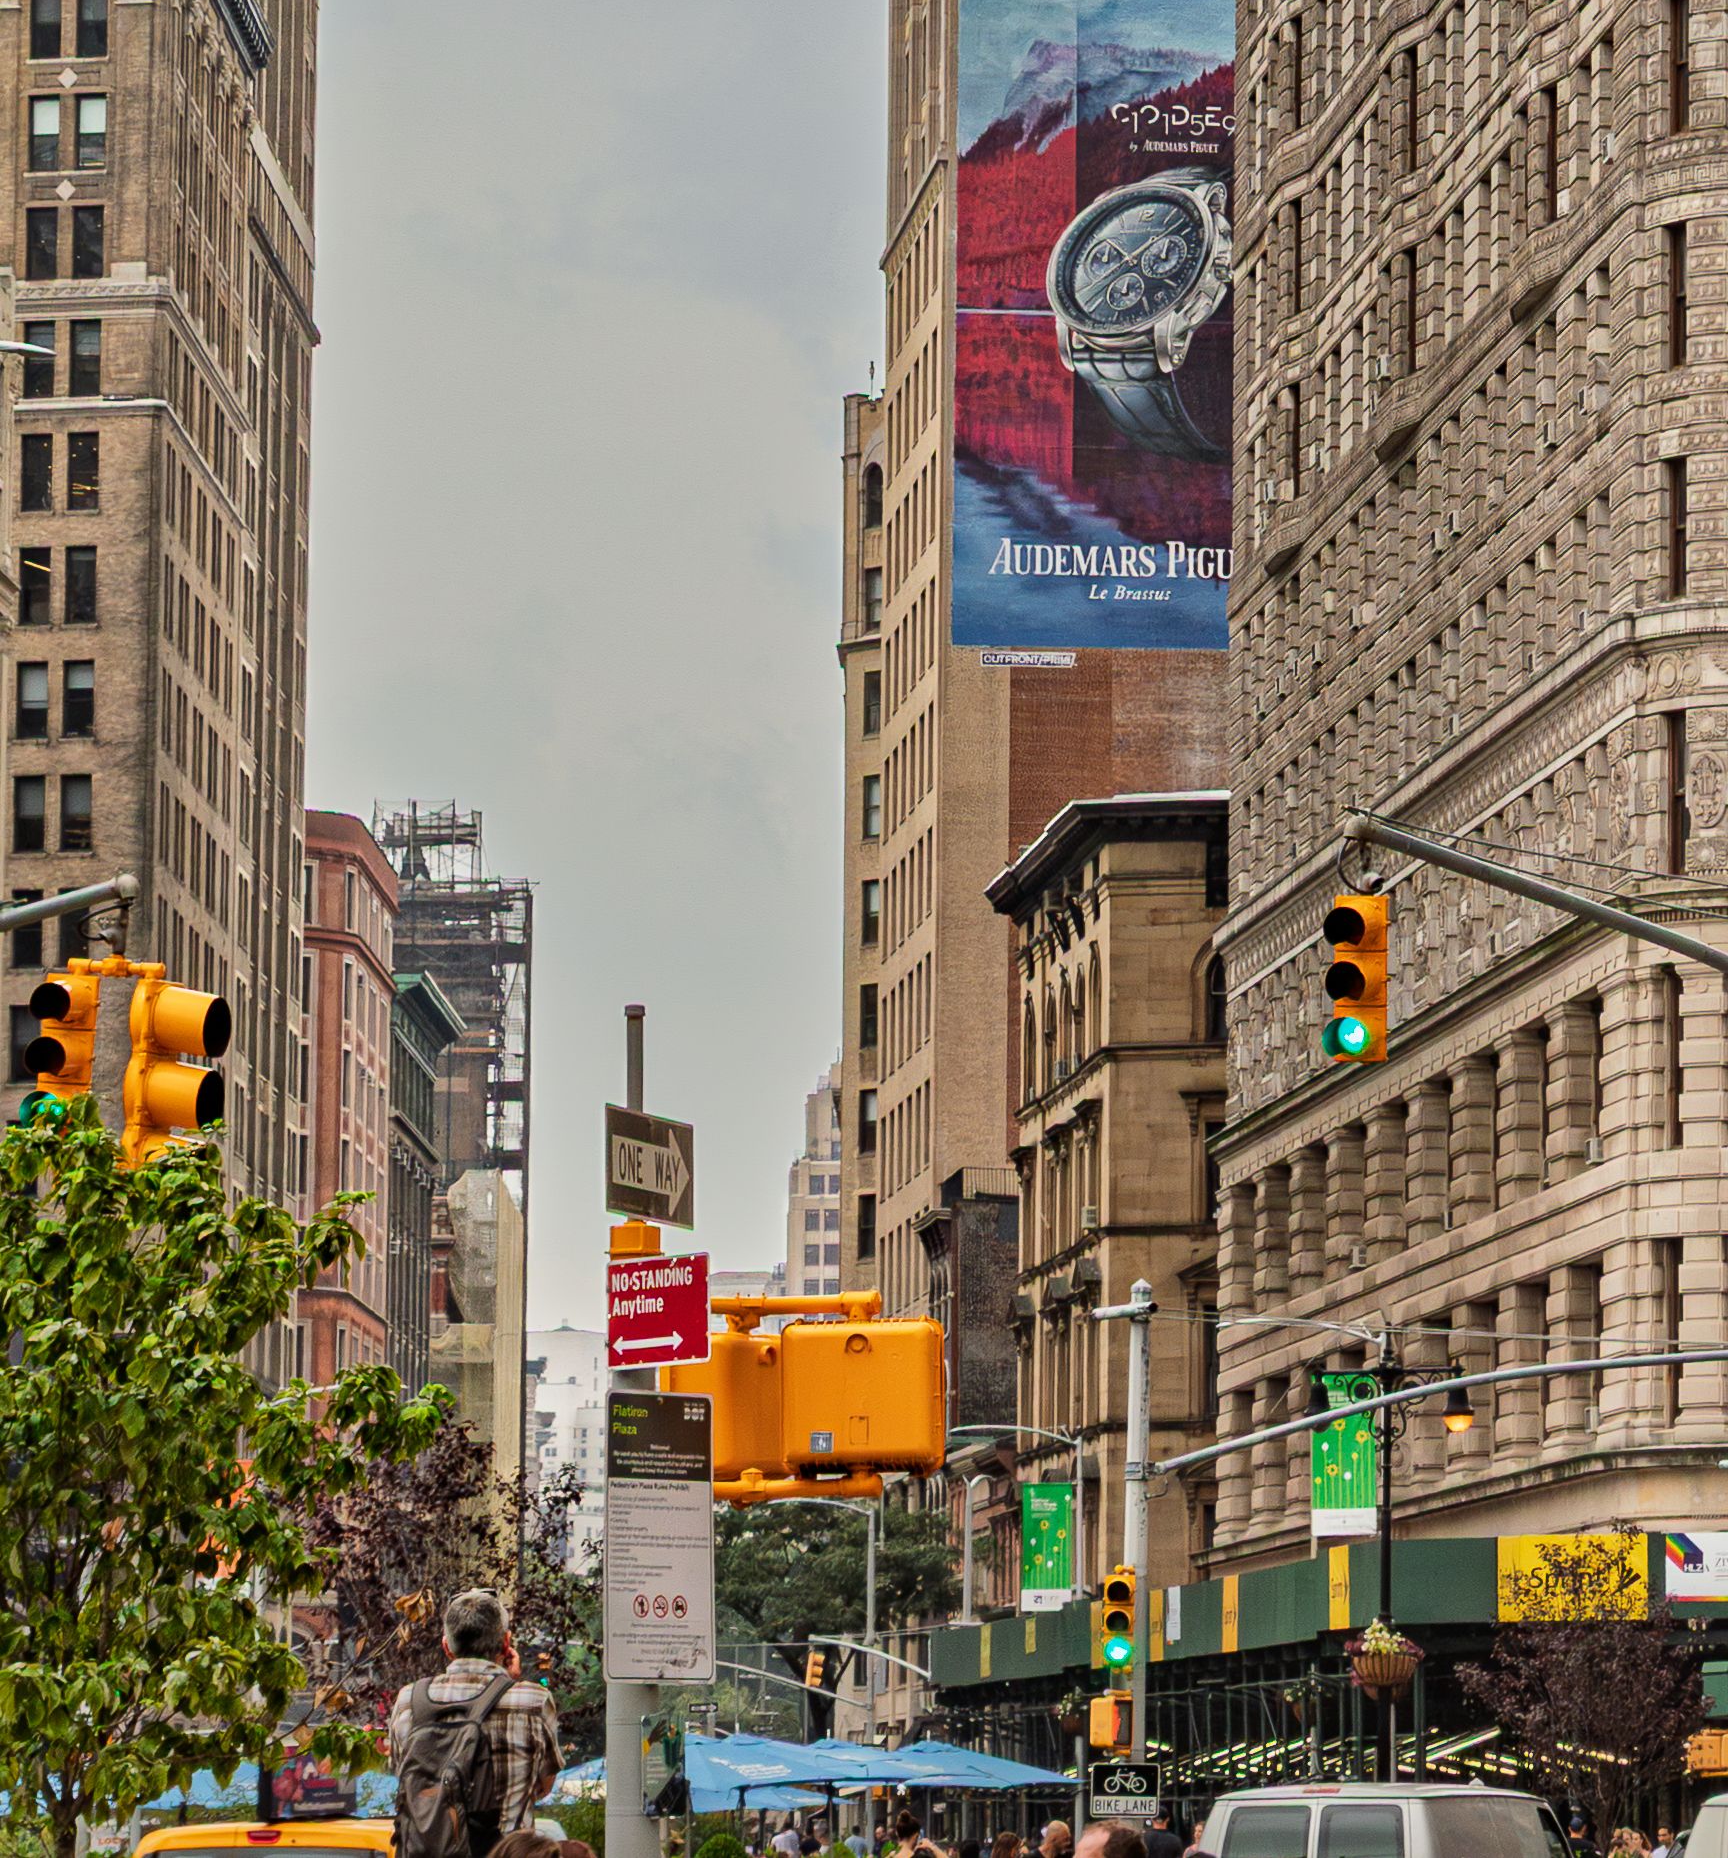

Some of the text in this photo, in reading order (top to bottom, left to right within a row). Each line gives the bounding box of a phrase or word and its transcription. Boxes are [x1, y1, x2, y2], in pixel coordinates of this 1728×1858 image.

[1190, 141, 1219, 153] PIGUET
[987, 537, 1157, 578] AUDEMARS
[1088, 584, 1172, 601] Le Brassus
[618, 1142, 681, 1193] ONE WAY
[612, 1266, 693, 1293] NO STANDING
[612, 1296, 664, 1319] Anytime
[613, 1404, 649, 1418] Flatiron
[613, 1422, 638, 1435] Plaza
[1095, 1799, 1155, 1812] BIKE LANE
